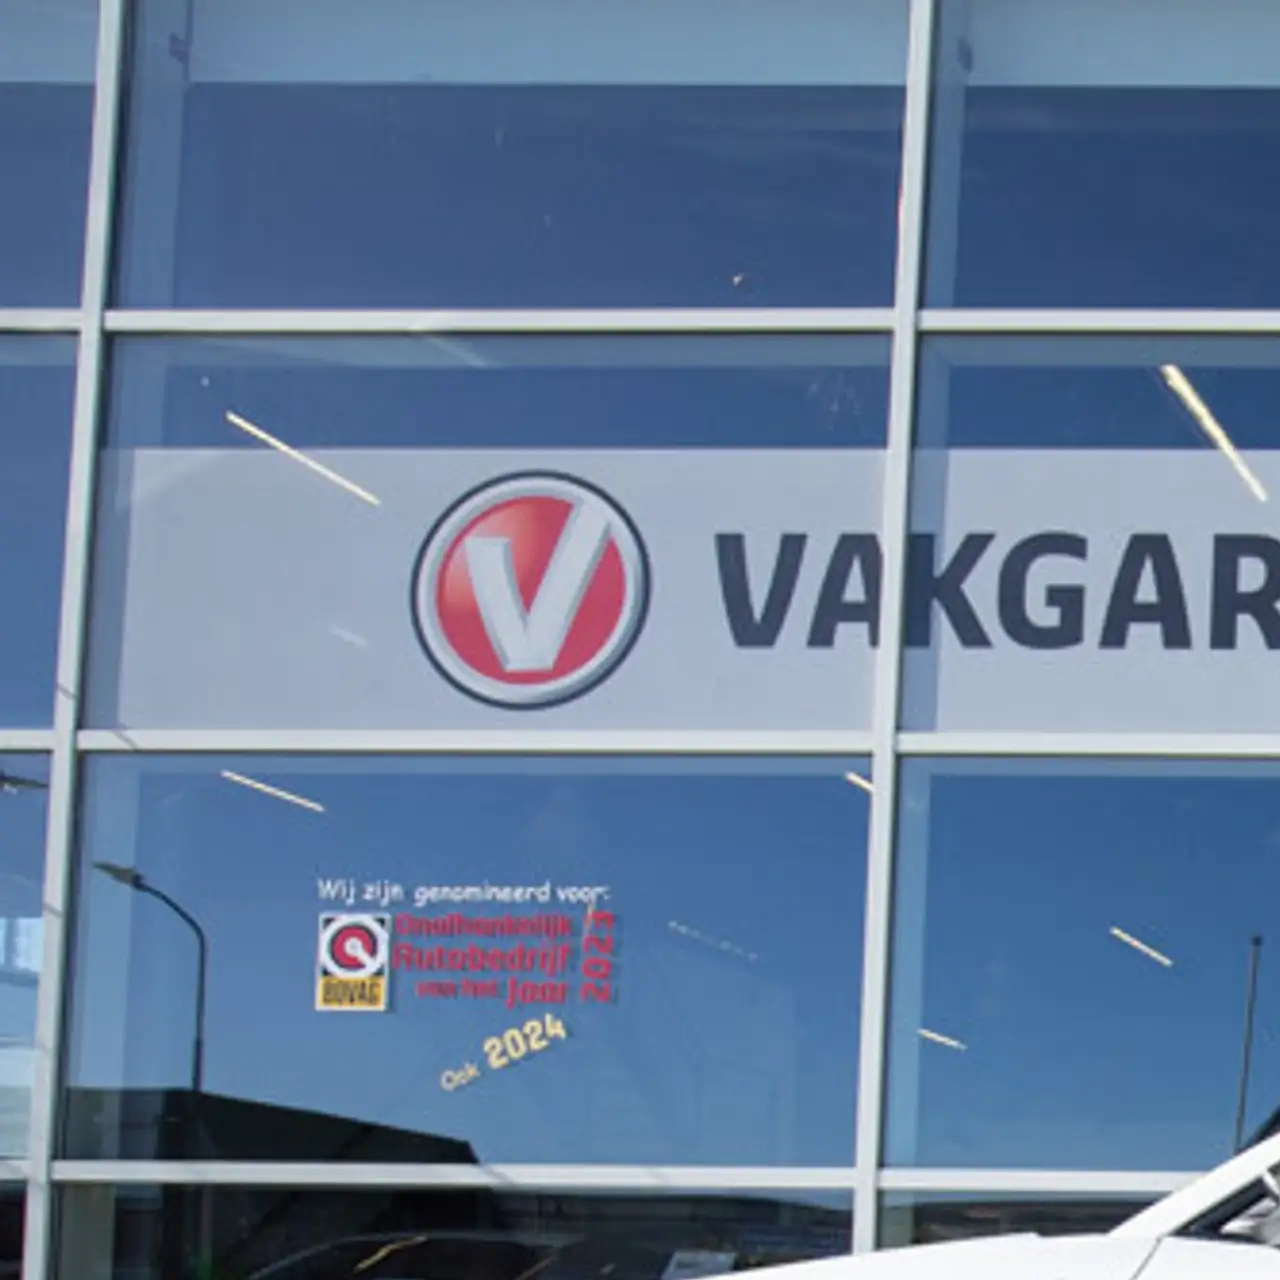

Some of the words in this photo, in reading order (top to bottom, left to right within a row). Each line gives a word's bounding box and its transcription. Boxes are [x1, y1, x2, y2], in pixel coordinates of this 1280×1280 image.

[318, 878, 356, 907] Wij
[362, 879, 405, 908] zijn
[483, 1012, 567, 1070] 2024
